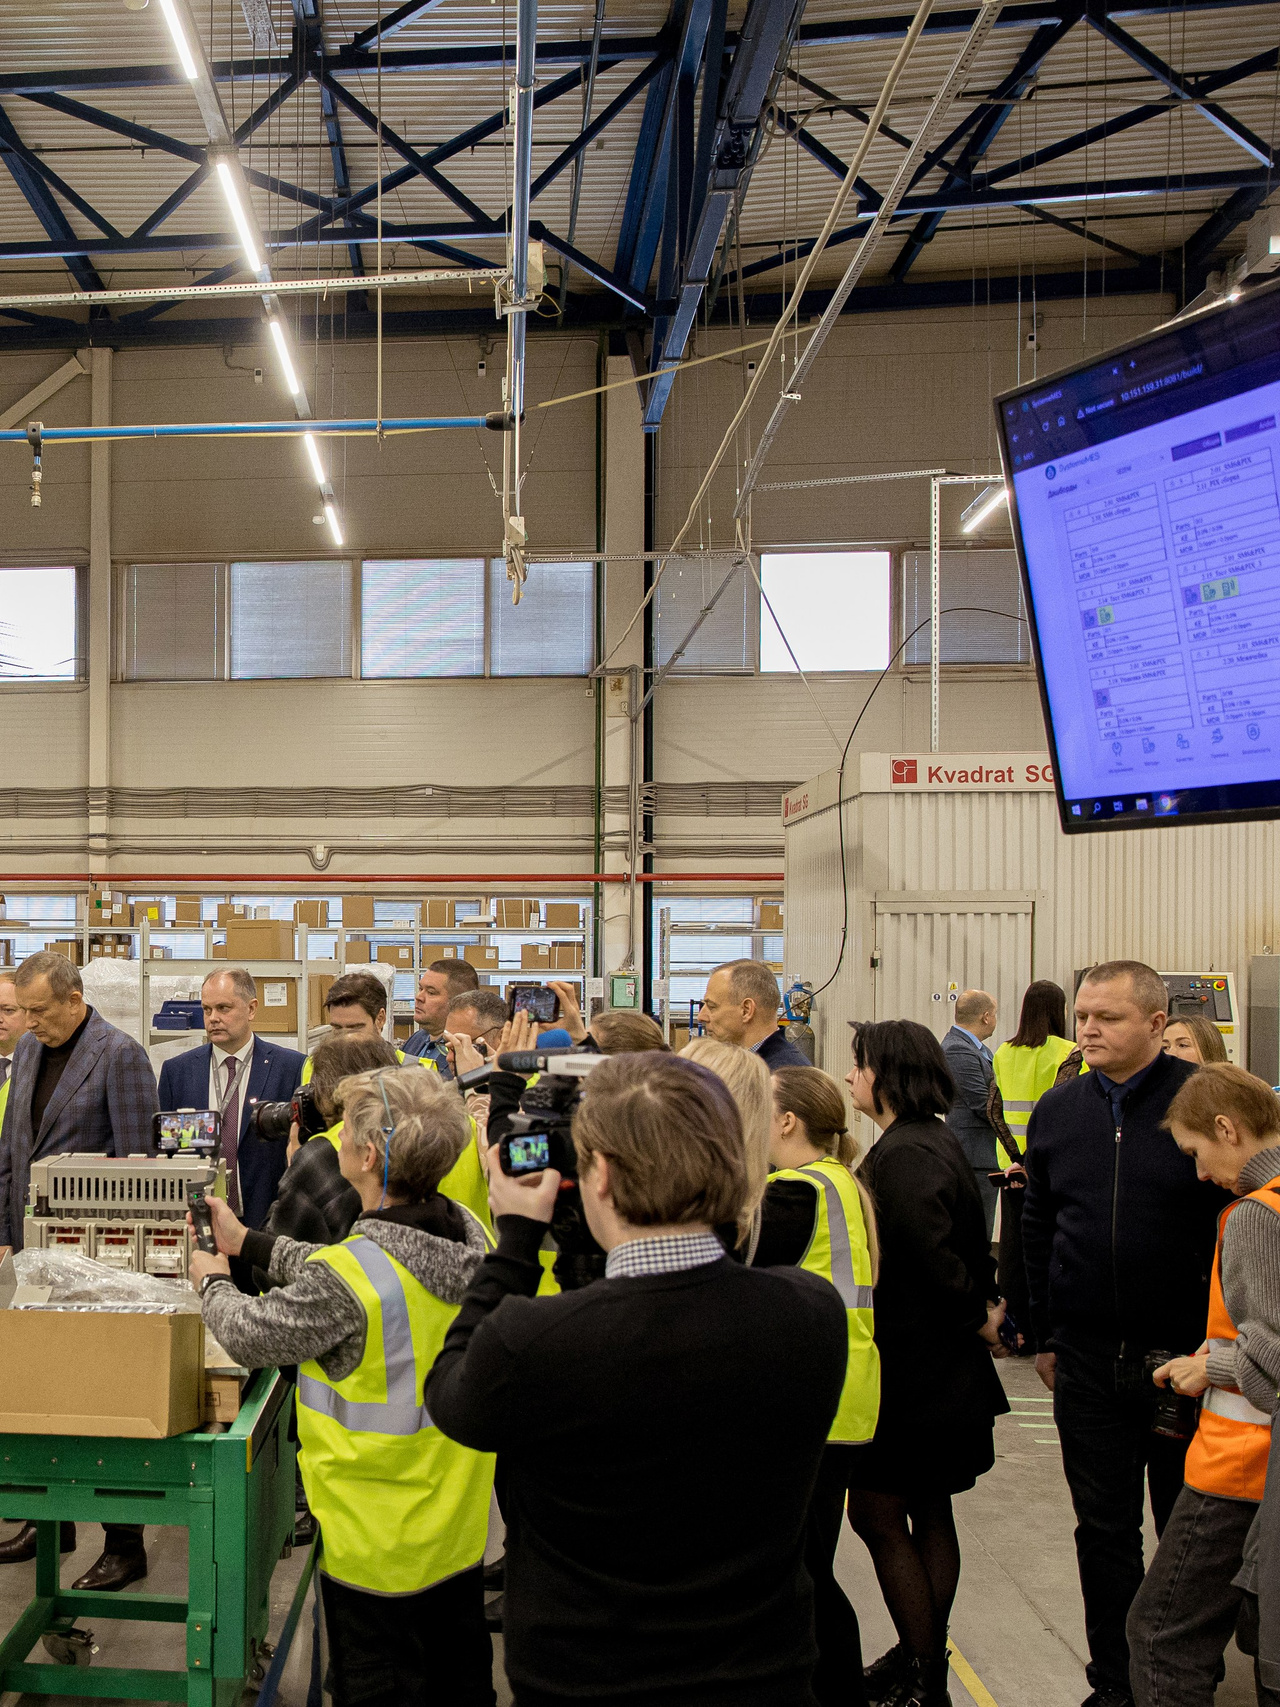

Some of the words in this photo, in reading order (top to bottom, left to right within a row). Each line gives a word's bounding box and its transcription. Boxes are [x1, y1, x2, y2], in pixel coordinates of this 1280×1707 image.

[1086, 404, 1095, 414] Not
[1097, 398, 1114, 410] secure
[928, 766, 1014, 783] Kvadrat
[1025, 765, 1054, 783] SG
